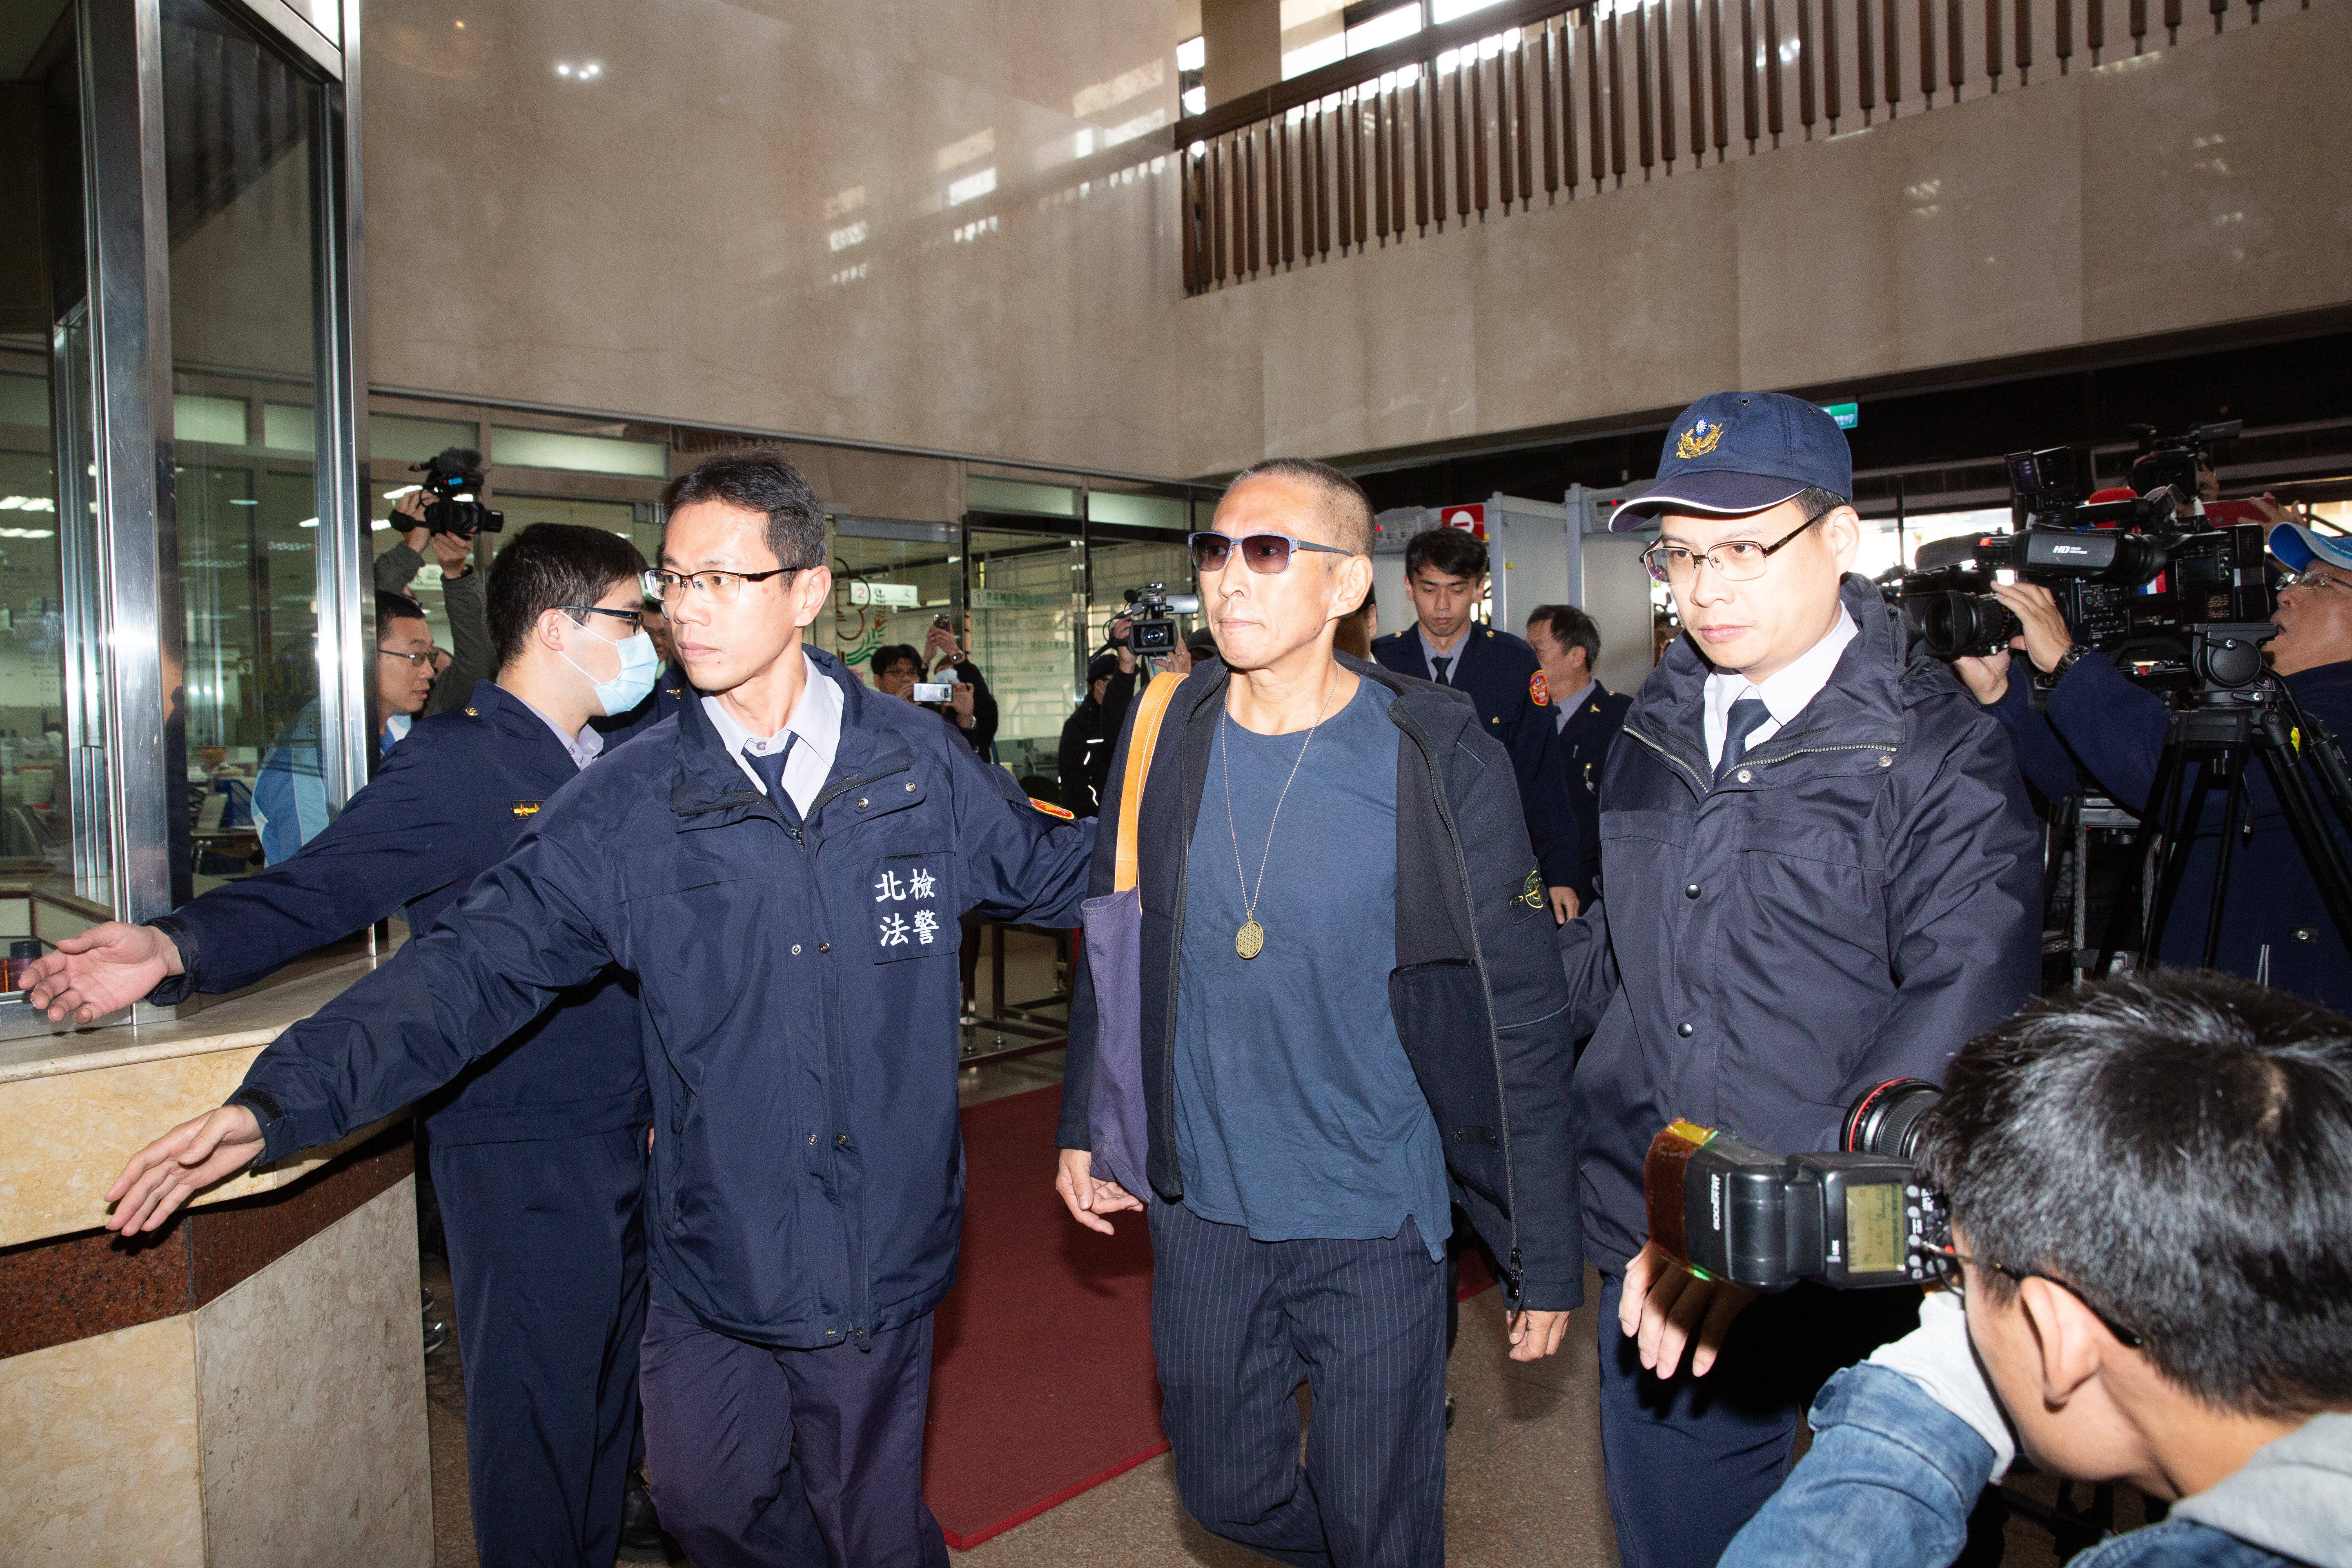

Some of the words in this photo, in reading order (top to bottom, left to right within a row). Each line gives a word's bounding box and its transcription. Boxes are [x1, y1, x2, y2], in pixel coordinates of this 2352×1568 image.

[858, 588, 864, 599] 2
[875, 869, 935, 902] 北檢
[880, 909, 939, 947] 法警
